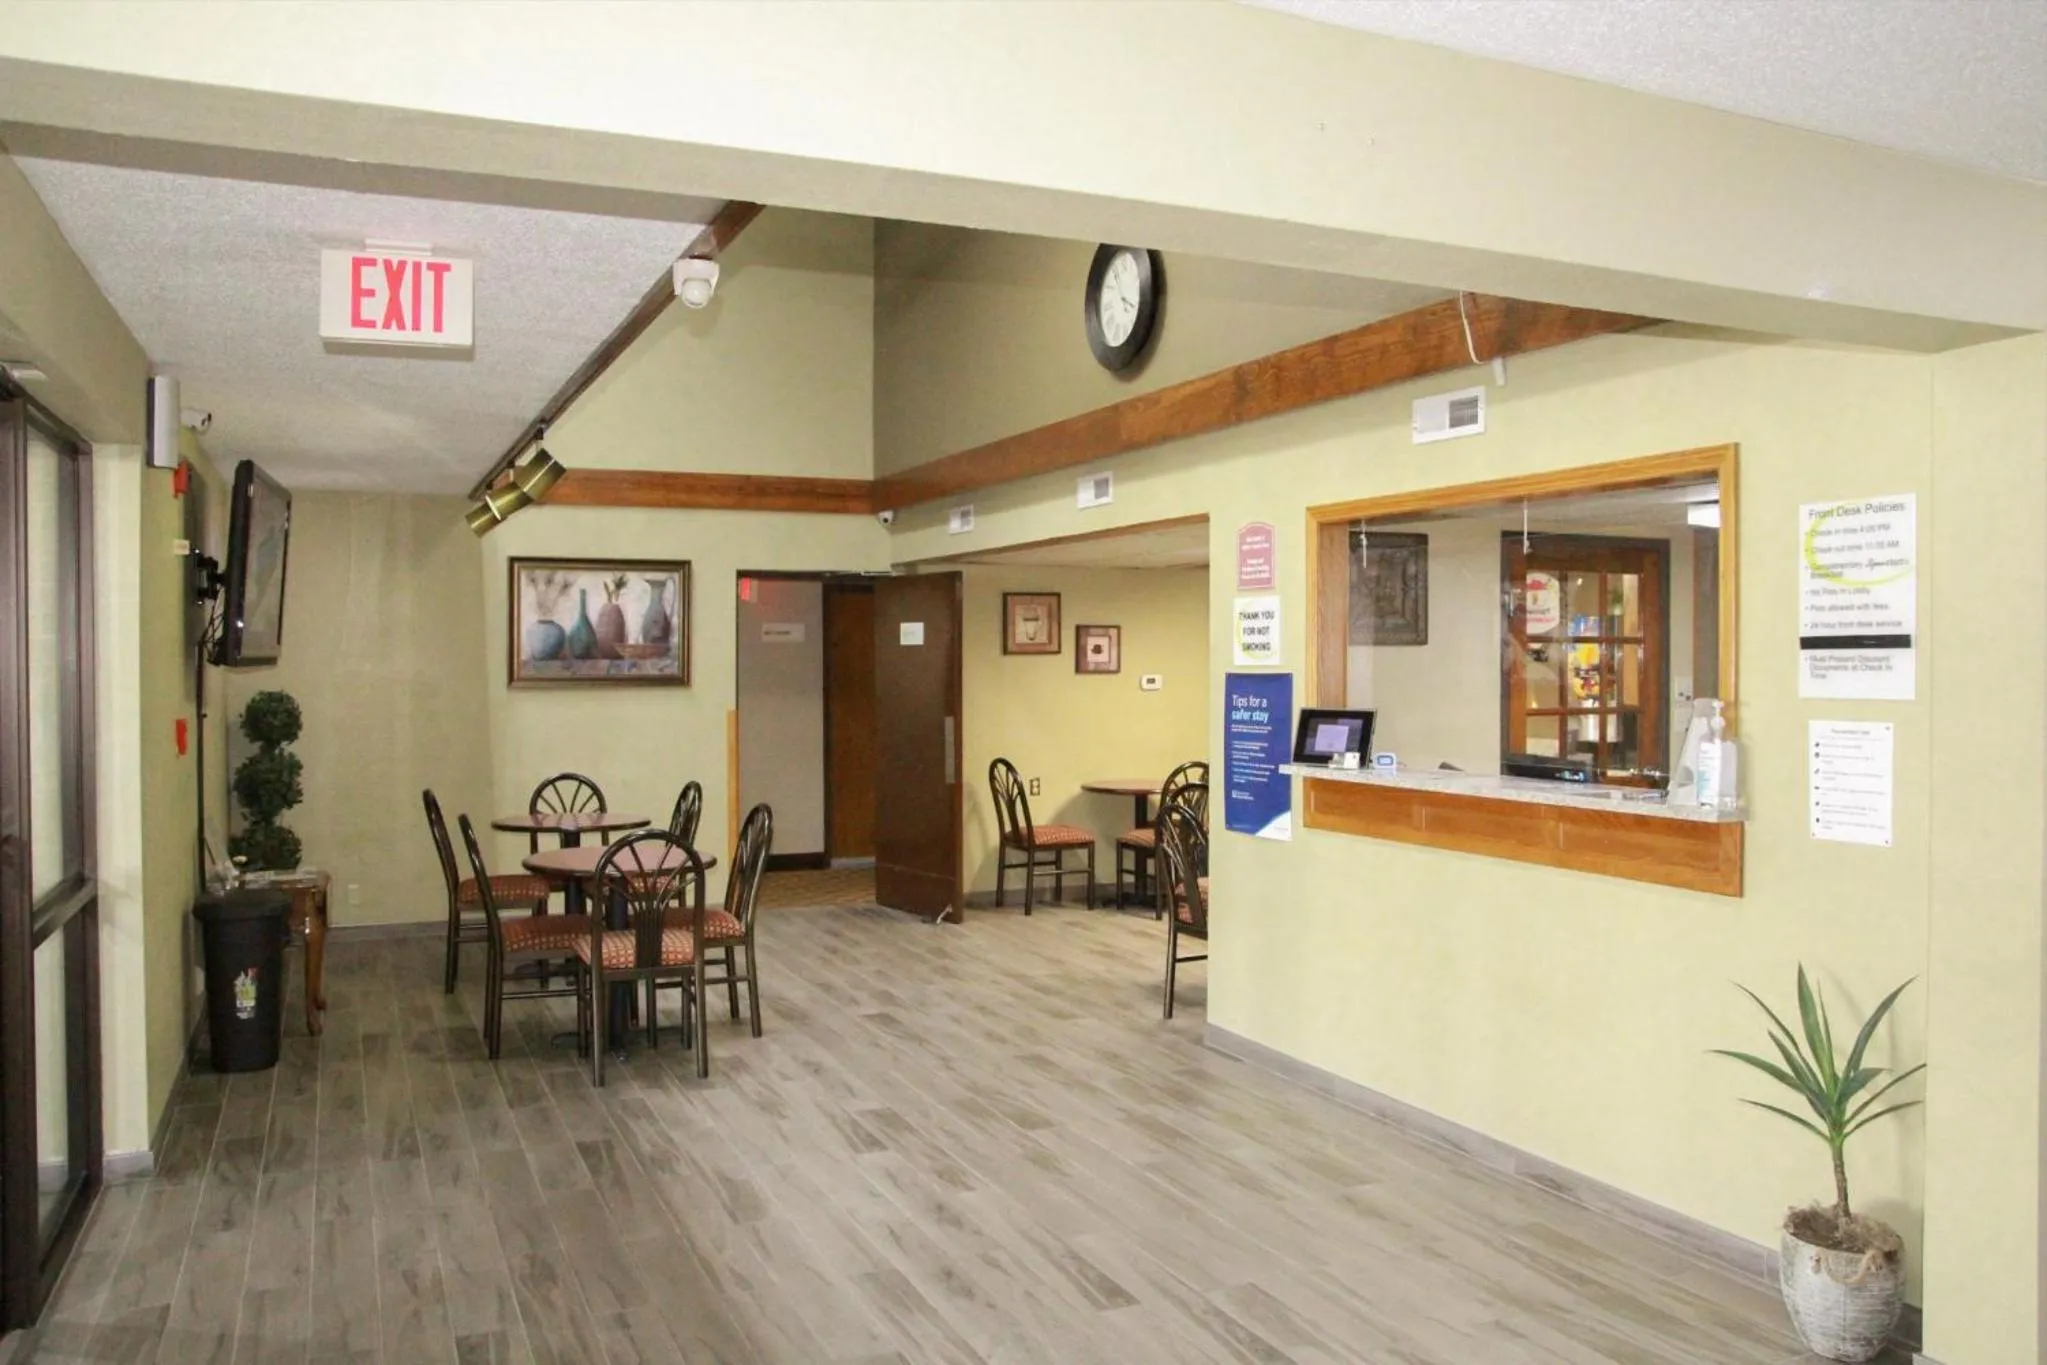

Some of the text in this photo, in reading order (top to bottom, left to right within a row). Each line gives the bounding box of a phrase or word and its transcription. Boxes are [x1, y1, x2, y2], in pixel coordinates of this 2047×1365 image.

[351, 256, 452, 333] EXIT
[1809, 502, 1906, 519] Front Desk Policies
[1239, 611, 1275, 621] THANK YOU
[1243, 626, 1270, 636] FOR NOT
[1242, 642, 1271, 652] SMOKING
[1232, 694, 1267, 708] Tips for a
[1231, 709, 1269, 724] safer stay
